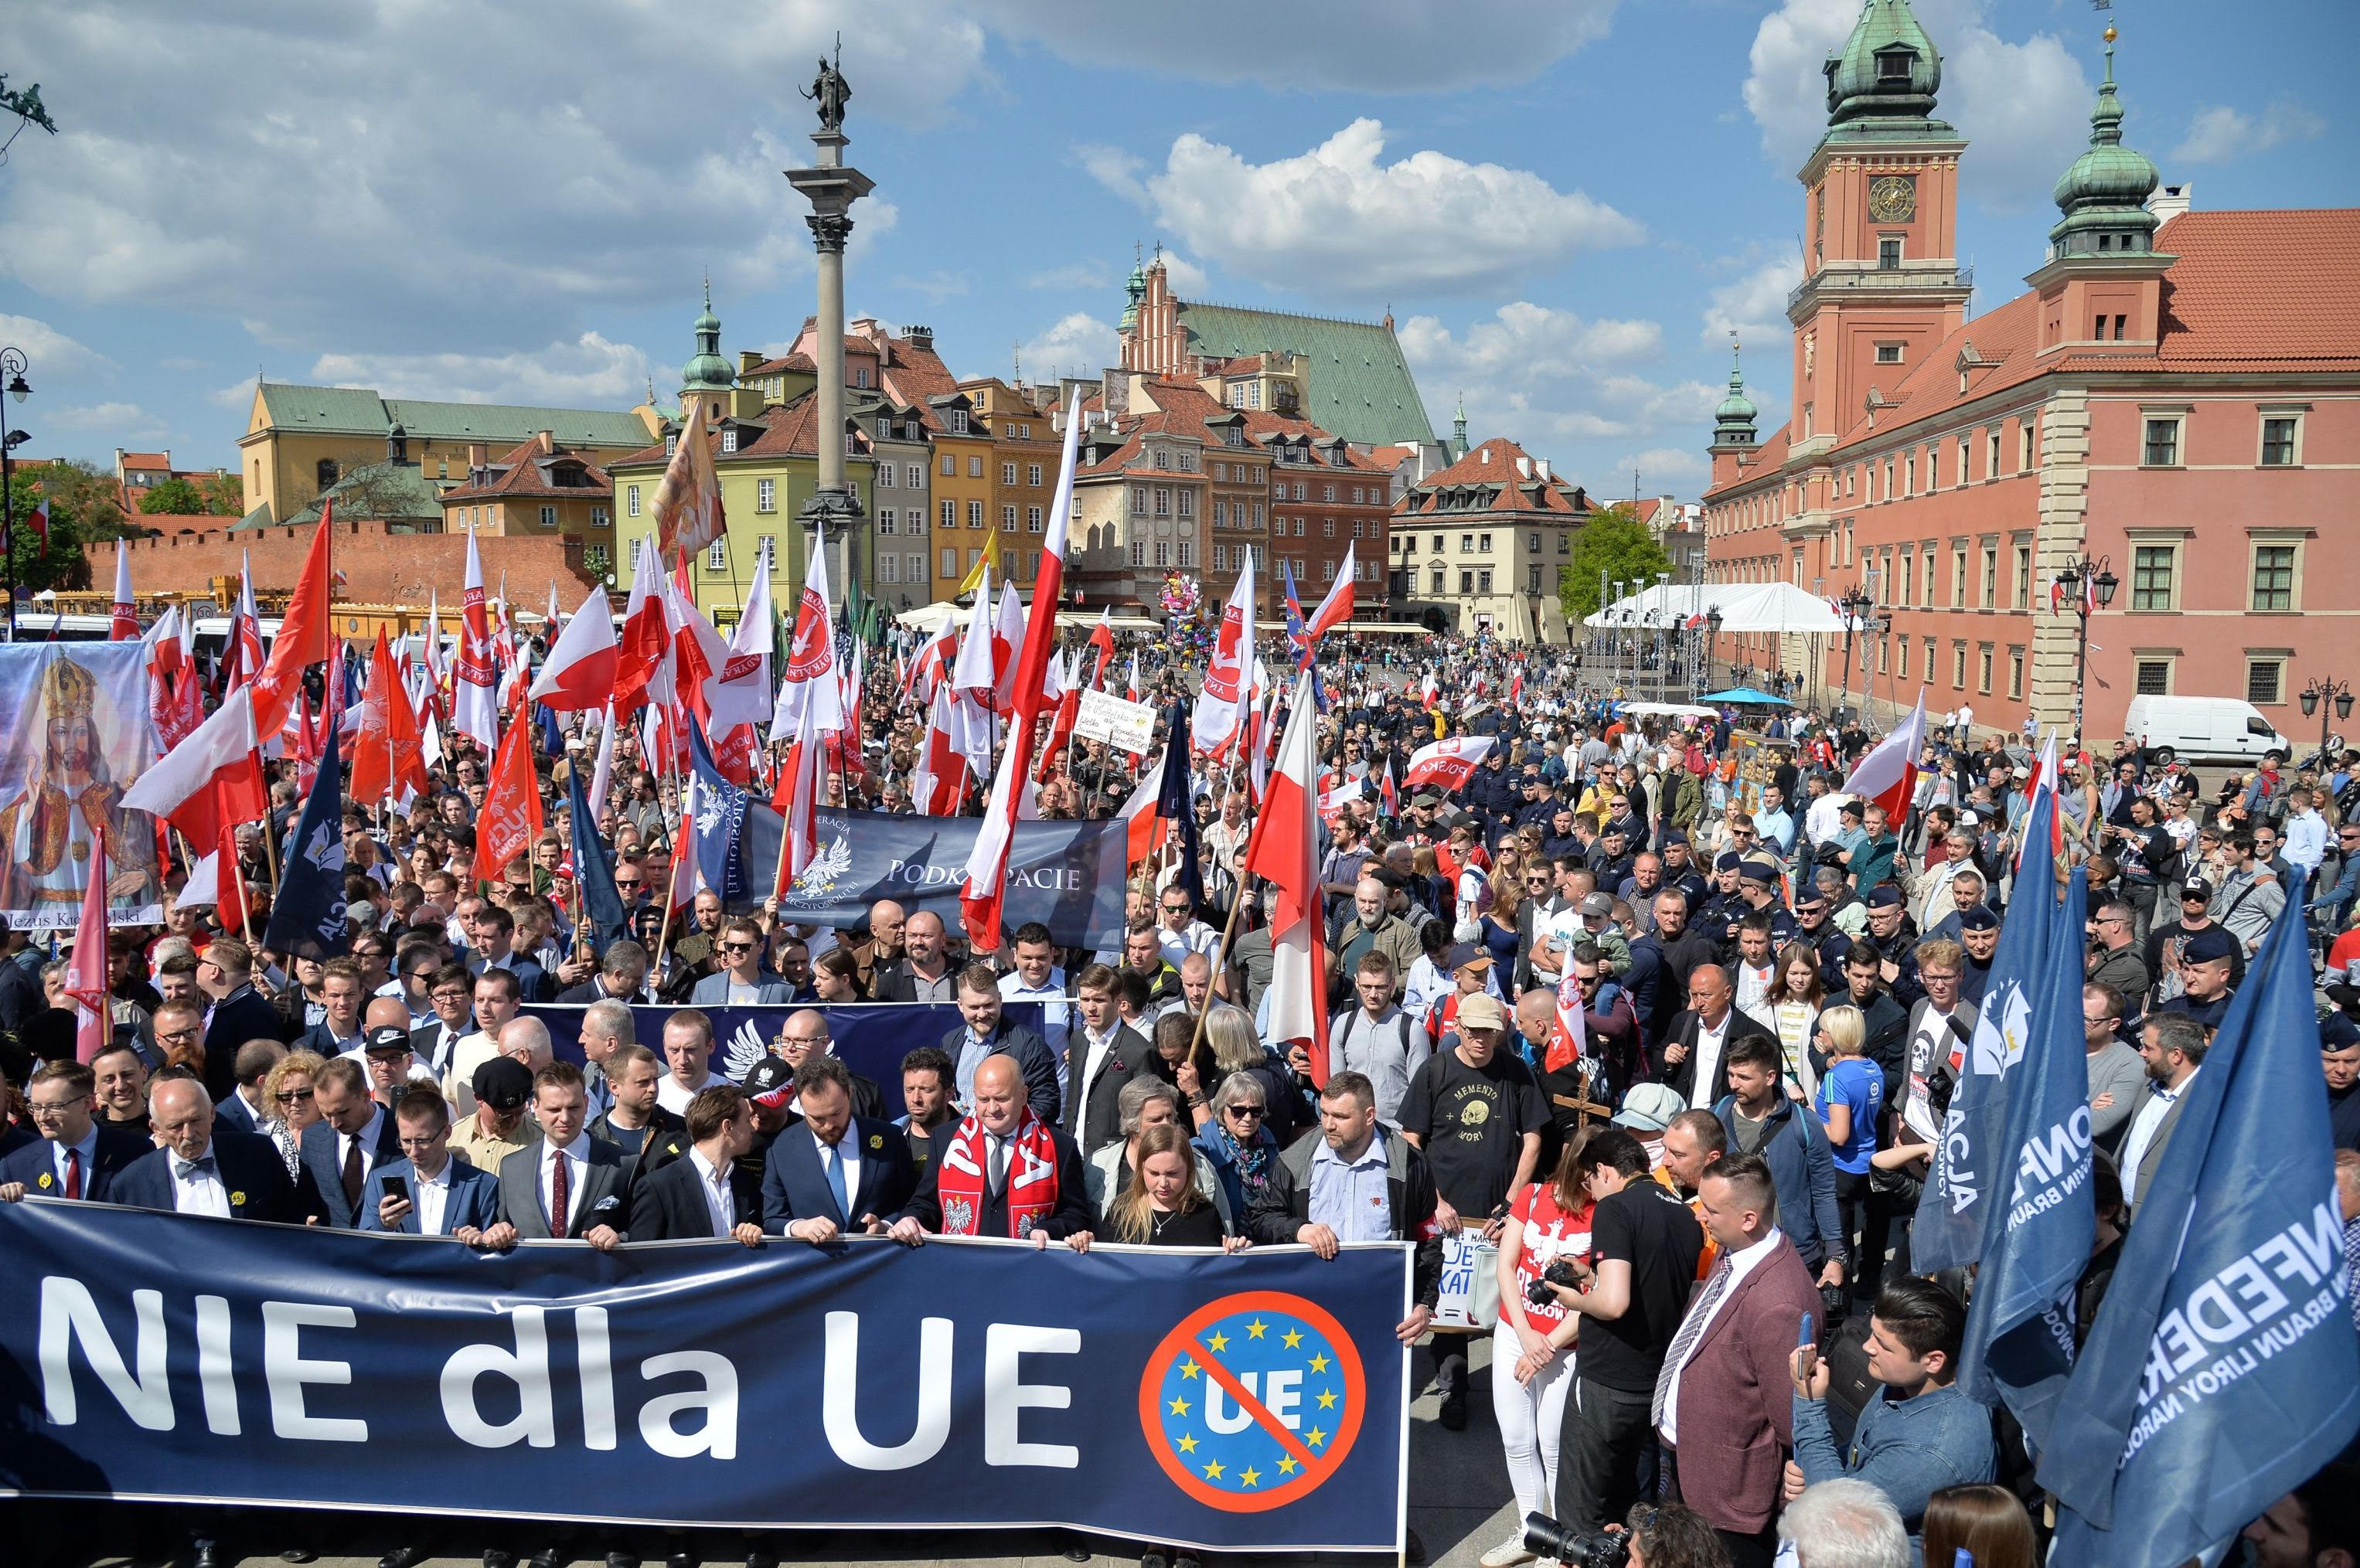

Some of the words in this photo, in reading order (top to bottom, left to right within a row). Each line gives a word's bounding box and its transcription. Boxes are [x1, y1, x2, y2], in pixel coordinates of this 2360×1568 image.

[199, 610, 211, 618] 30
[886, 859, 1081, 891] PODKPACIE
[9, 913, 50, 928] Jezus
[381, 1029, 400, 1039] NIKE
[1454, 1083, 1498, 1101] MEMENTO
[1458, 1130, 1483, 1142] MORI
[38, 1276, 369, 1442] NIE
[439, 1304, 739, 1460] dla
[822, 1311, 1081, 1471] UE
[1204, 1369, 1304, 1435] UE
